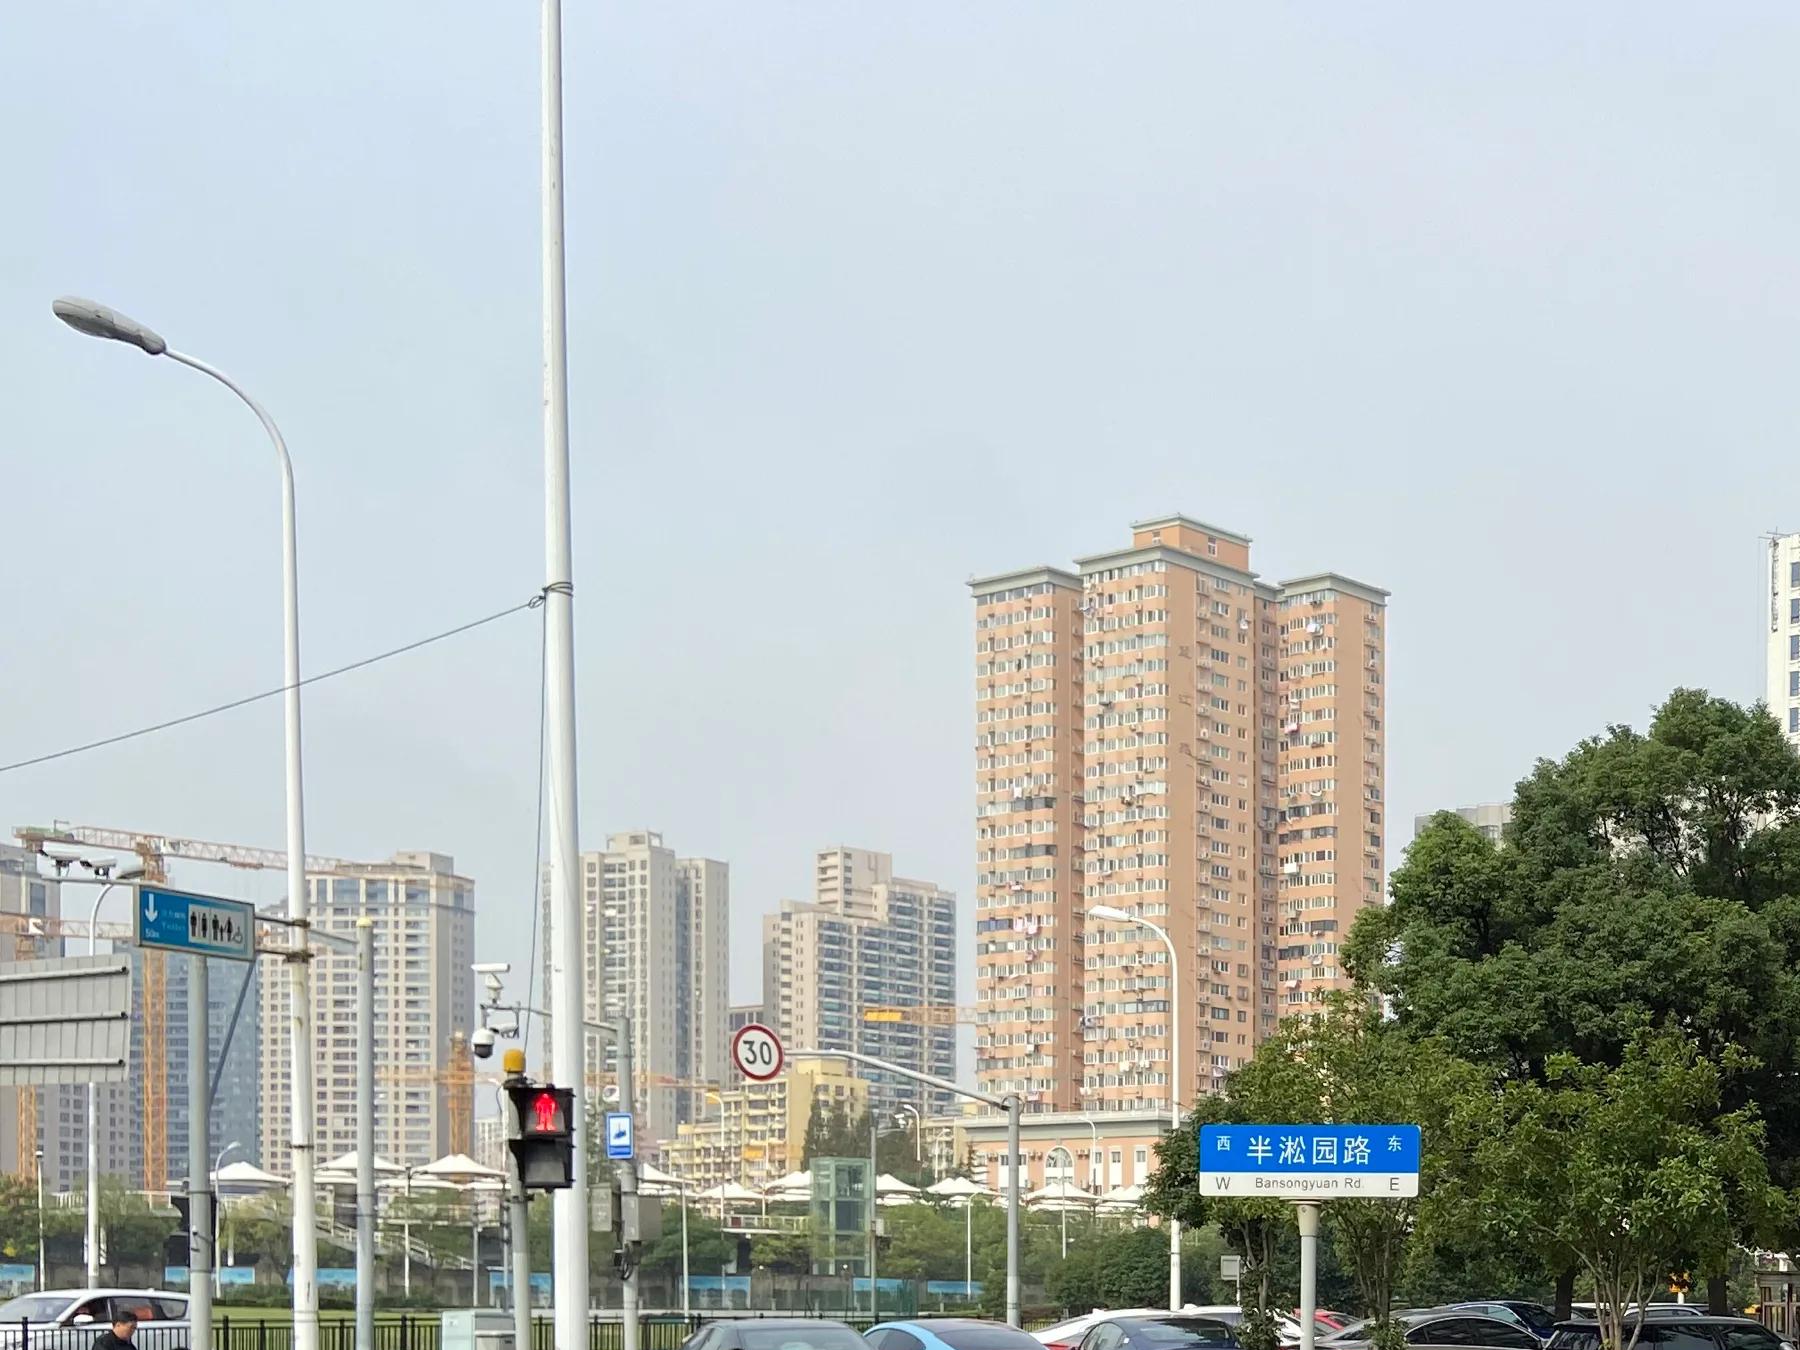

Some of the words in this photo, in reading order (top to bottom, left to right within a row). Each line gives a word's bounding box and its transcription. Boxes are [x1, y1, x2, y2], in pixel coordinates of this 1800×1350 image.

[742, 1040, 772, 1066] 30
[1216, 1135, 1231, 1151] 西
[1246, 1135, 1371, 1165] 半淞园路
[1387, 1135, 1402, 1152] 东
[1216, 1176, 1231, 1190] W
[1255, 1177, 1338, 1192] Bansongyuan
[1390, 1177, 1400, 1191] E
